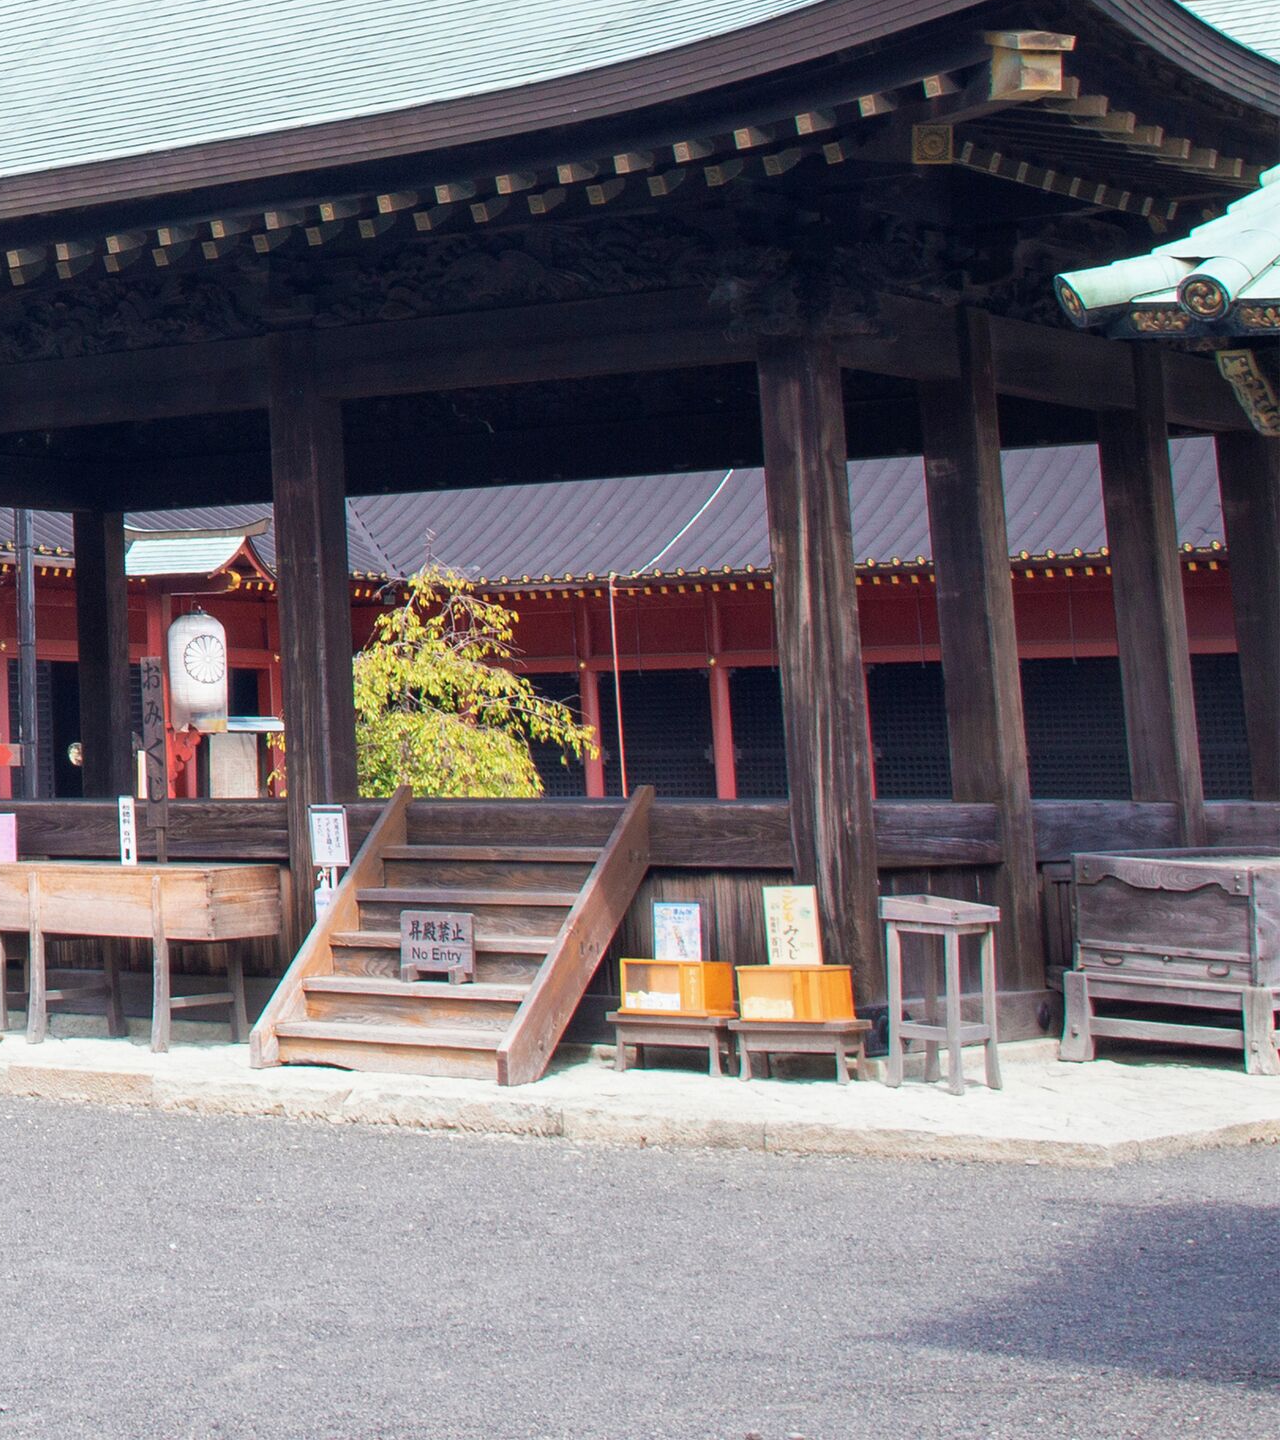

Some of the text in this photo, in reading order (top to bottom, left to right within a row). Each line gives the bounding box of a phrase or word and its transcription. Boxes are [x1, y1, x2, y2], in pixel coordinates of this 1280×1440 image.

[142, 661, 165, 804] おみくじ
[409, 920, 465, 943] 昇殿禁止
[782, 889, 799, 960] こどもみくじ
[412, 947, 462, 963] No Entry
